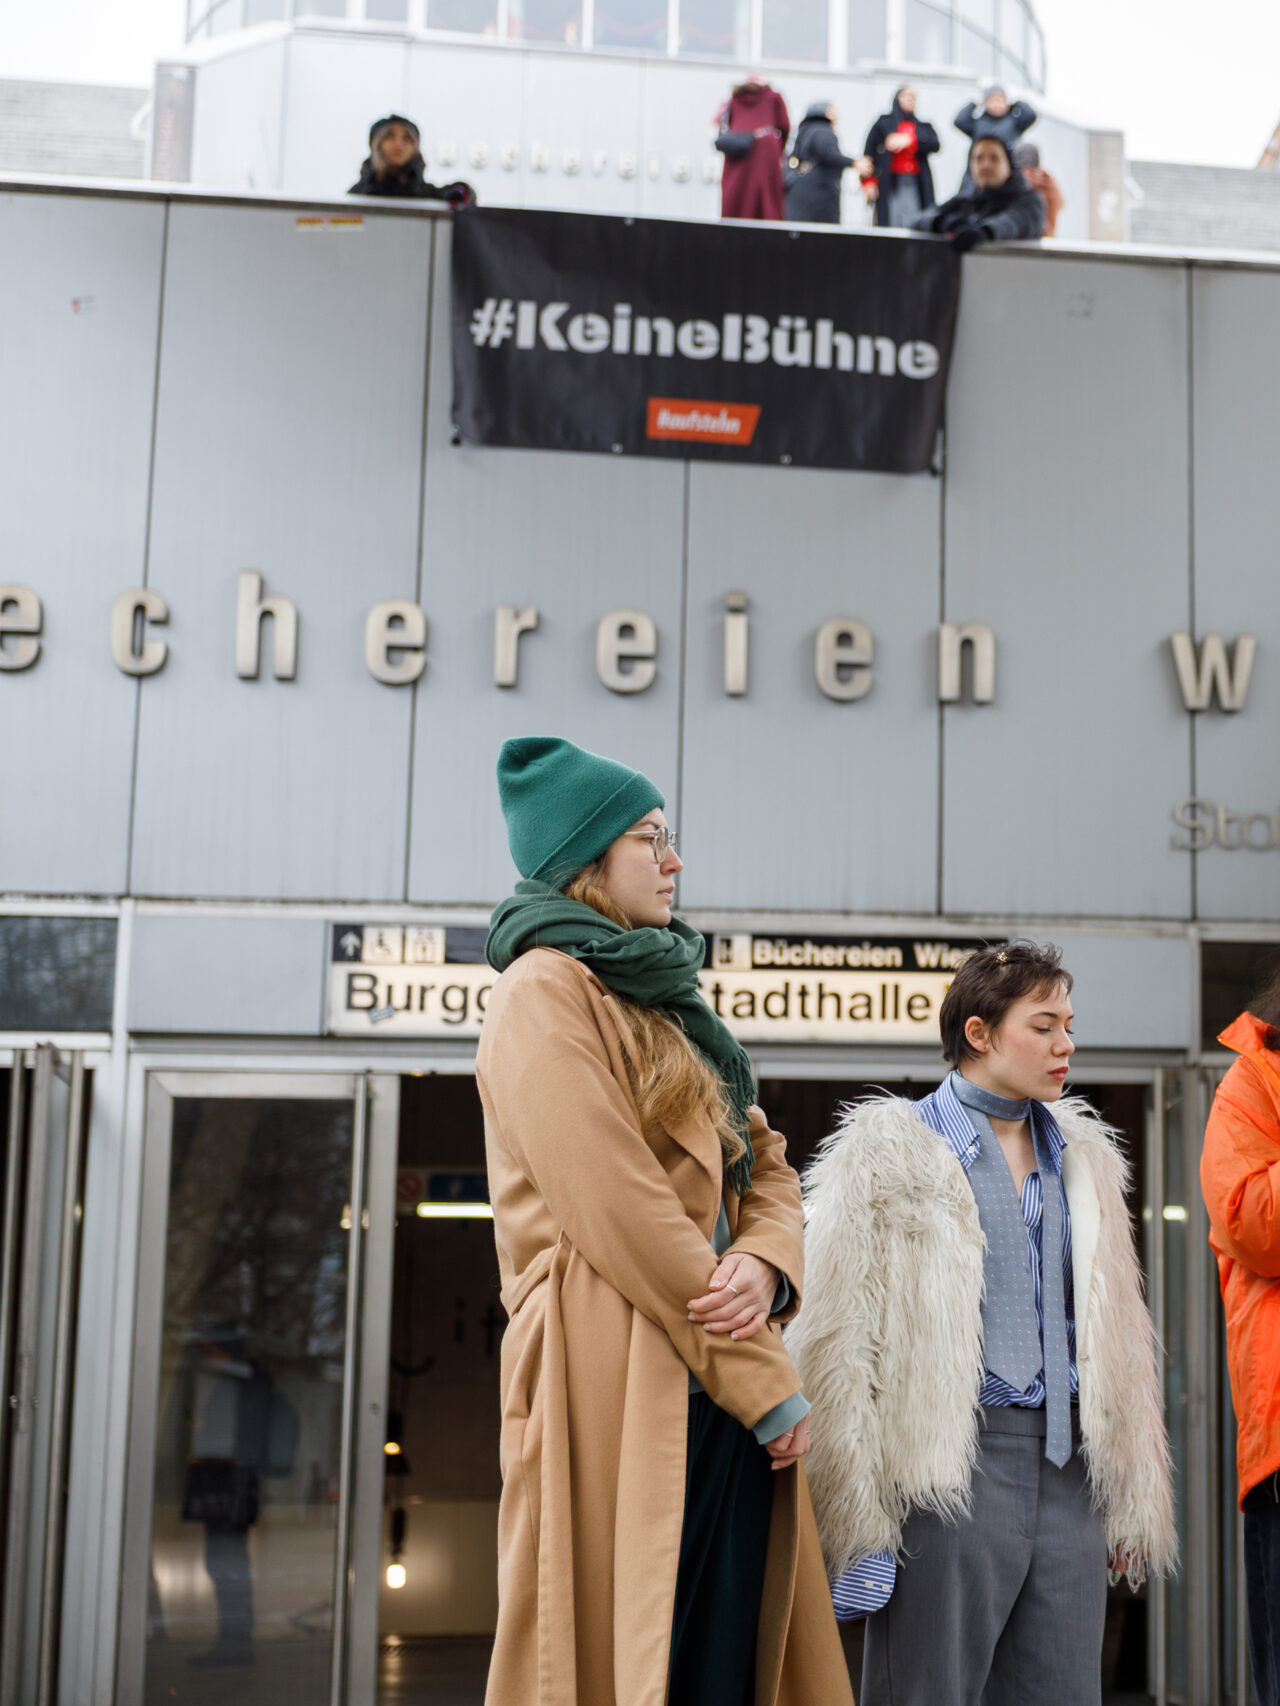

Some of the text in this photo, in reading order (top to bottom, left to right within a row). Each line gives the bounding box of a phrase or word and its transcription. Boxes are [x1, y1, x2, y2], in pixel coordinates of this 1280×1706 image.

[468, 297, 940, 380] #KeineBühne
[752, 938, 978, 969] Büchereien Wie
[697, 981, 931, 1022] tadthalle
